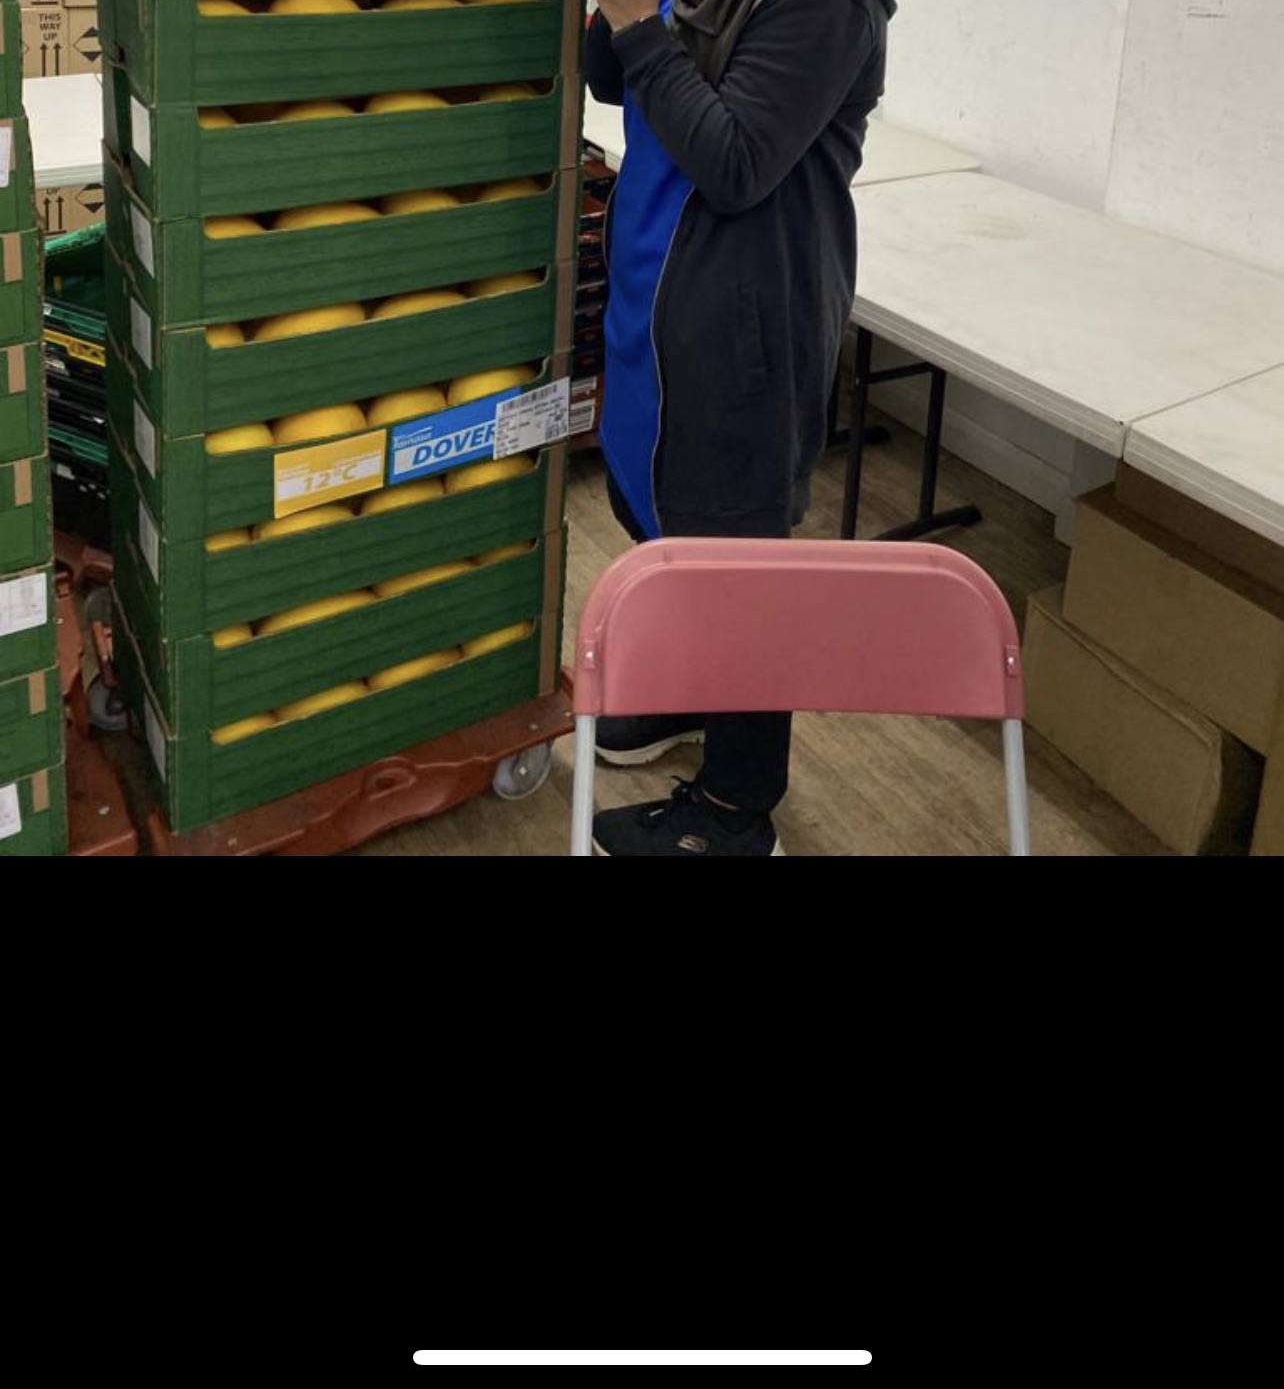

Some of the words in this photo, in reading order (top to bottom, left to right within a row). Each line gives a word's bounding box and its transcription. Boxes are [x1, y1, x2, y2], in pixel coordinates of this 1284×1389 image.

[39, 13, 61, 21] THIS
[40, 22, 60, 31] WAY
[43, 33, 57, 41] UP
